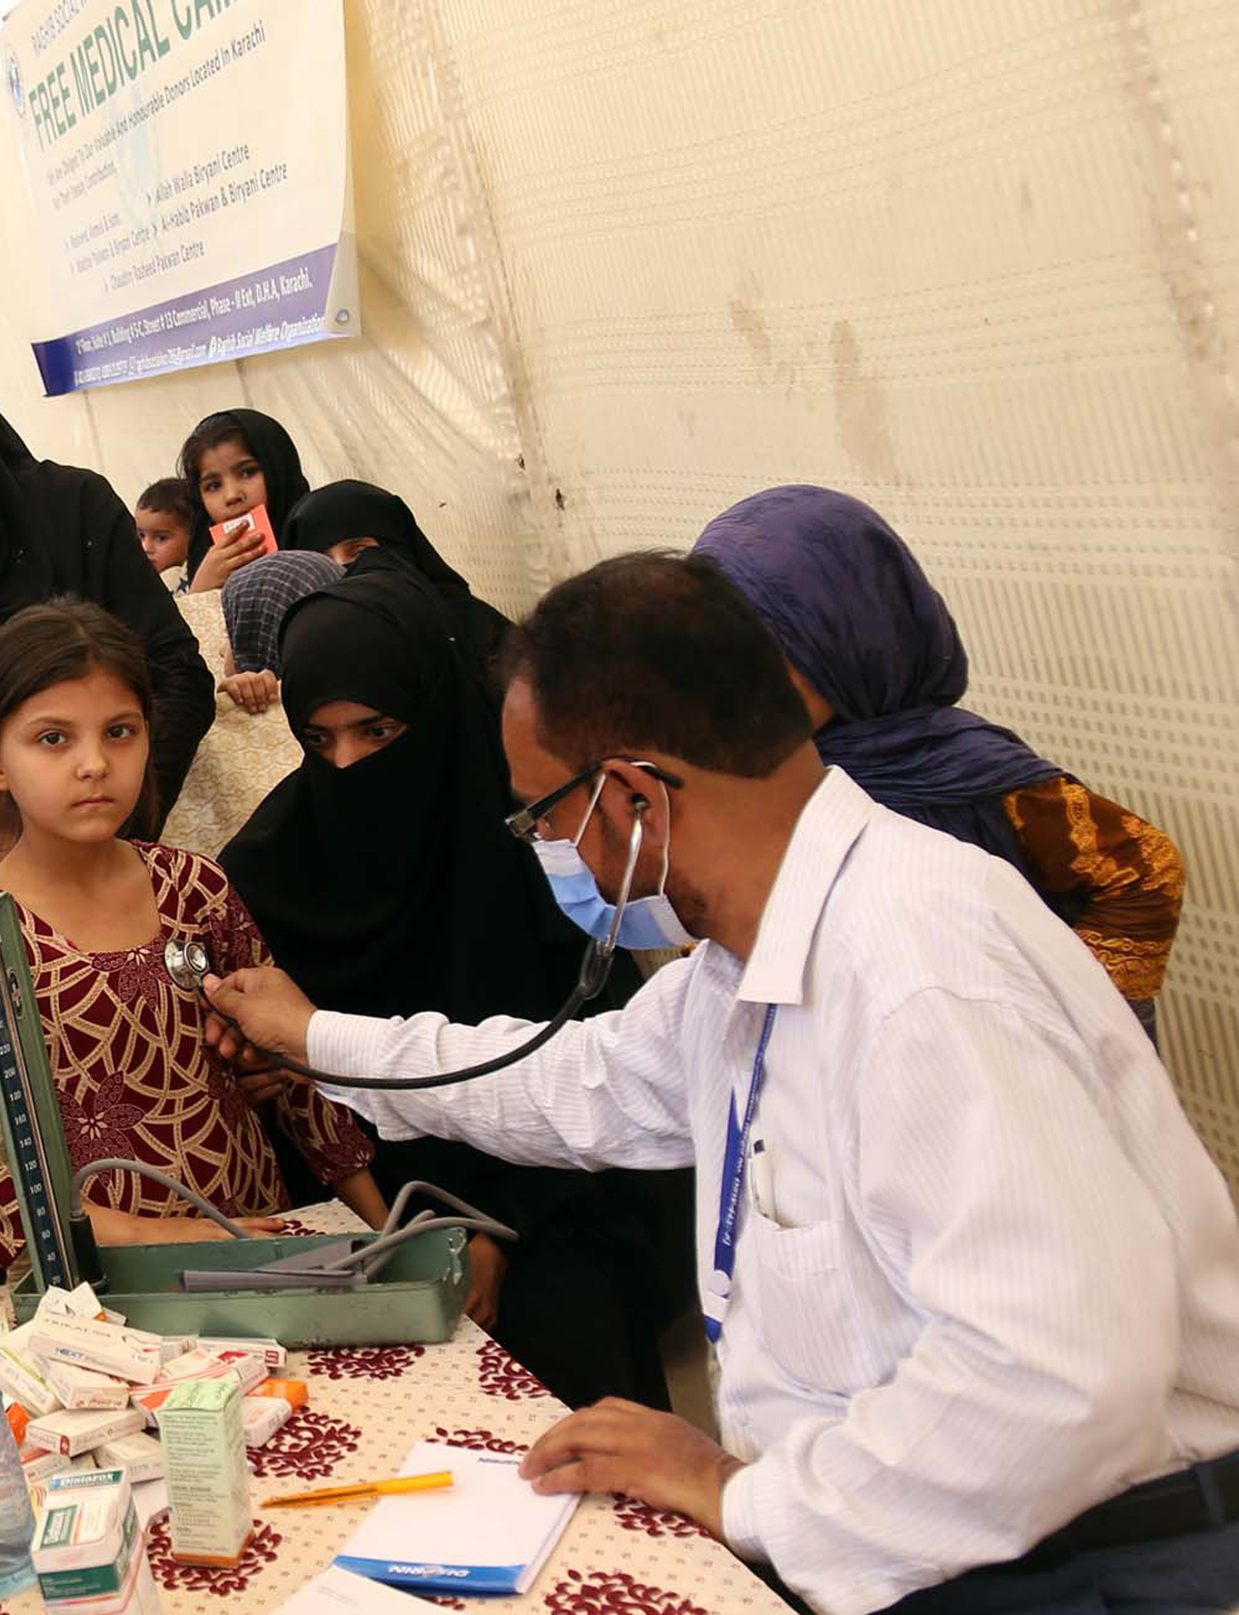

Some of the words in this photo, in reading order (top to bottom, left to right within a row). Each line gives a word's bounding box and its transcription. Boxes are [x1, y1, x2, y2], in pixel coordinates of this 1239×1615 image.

[28, 62, 77, 152] FREE
[70, 0, 171, 117] MEDICAL
[163, 76, 191, 105] Donors
[189, 50, 221, 88] Located
[219, 46, 231, 68] In
[229, 20, 267, 61] Karachi
[193, 155, 222, 185] Biryani
[221, 143, 250, 171] Centre
[189, 194, 221, 220] Pakwan
[220, 186, 229, 207] &
[228, 171, 260, 203] Biryani
[259, 163, 288, 190] Centre
[180, 240, 206, 263] Centre
[210, 297, 231, 317] Phase
[279, 267, 313, 296] Karachi.
[24, 1160, 37, 1172] 120
[29, 1183, 42, 1195] 100
